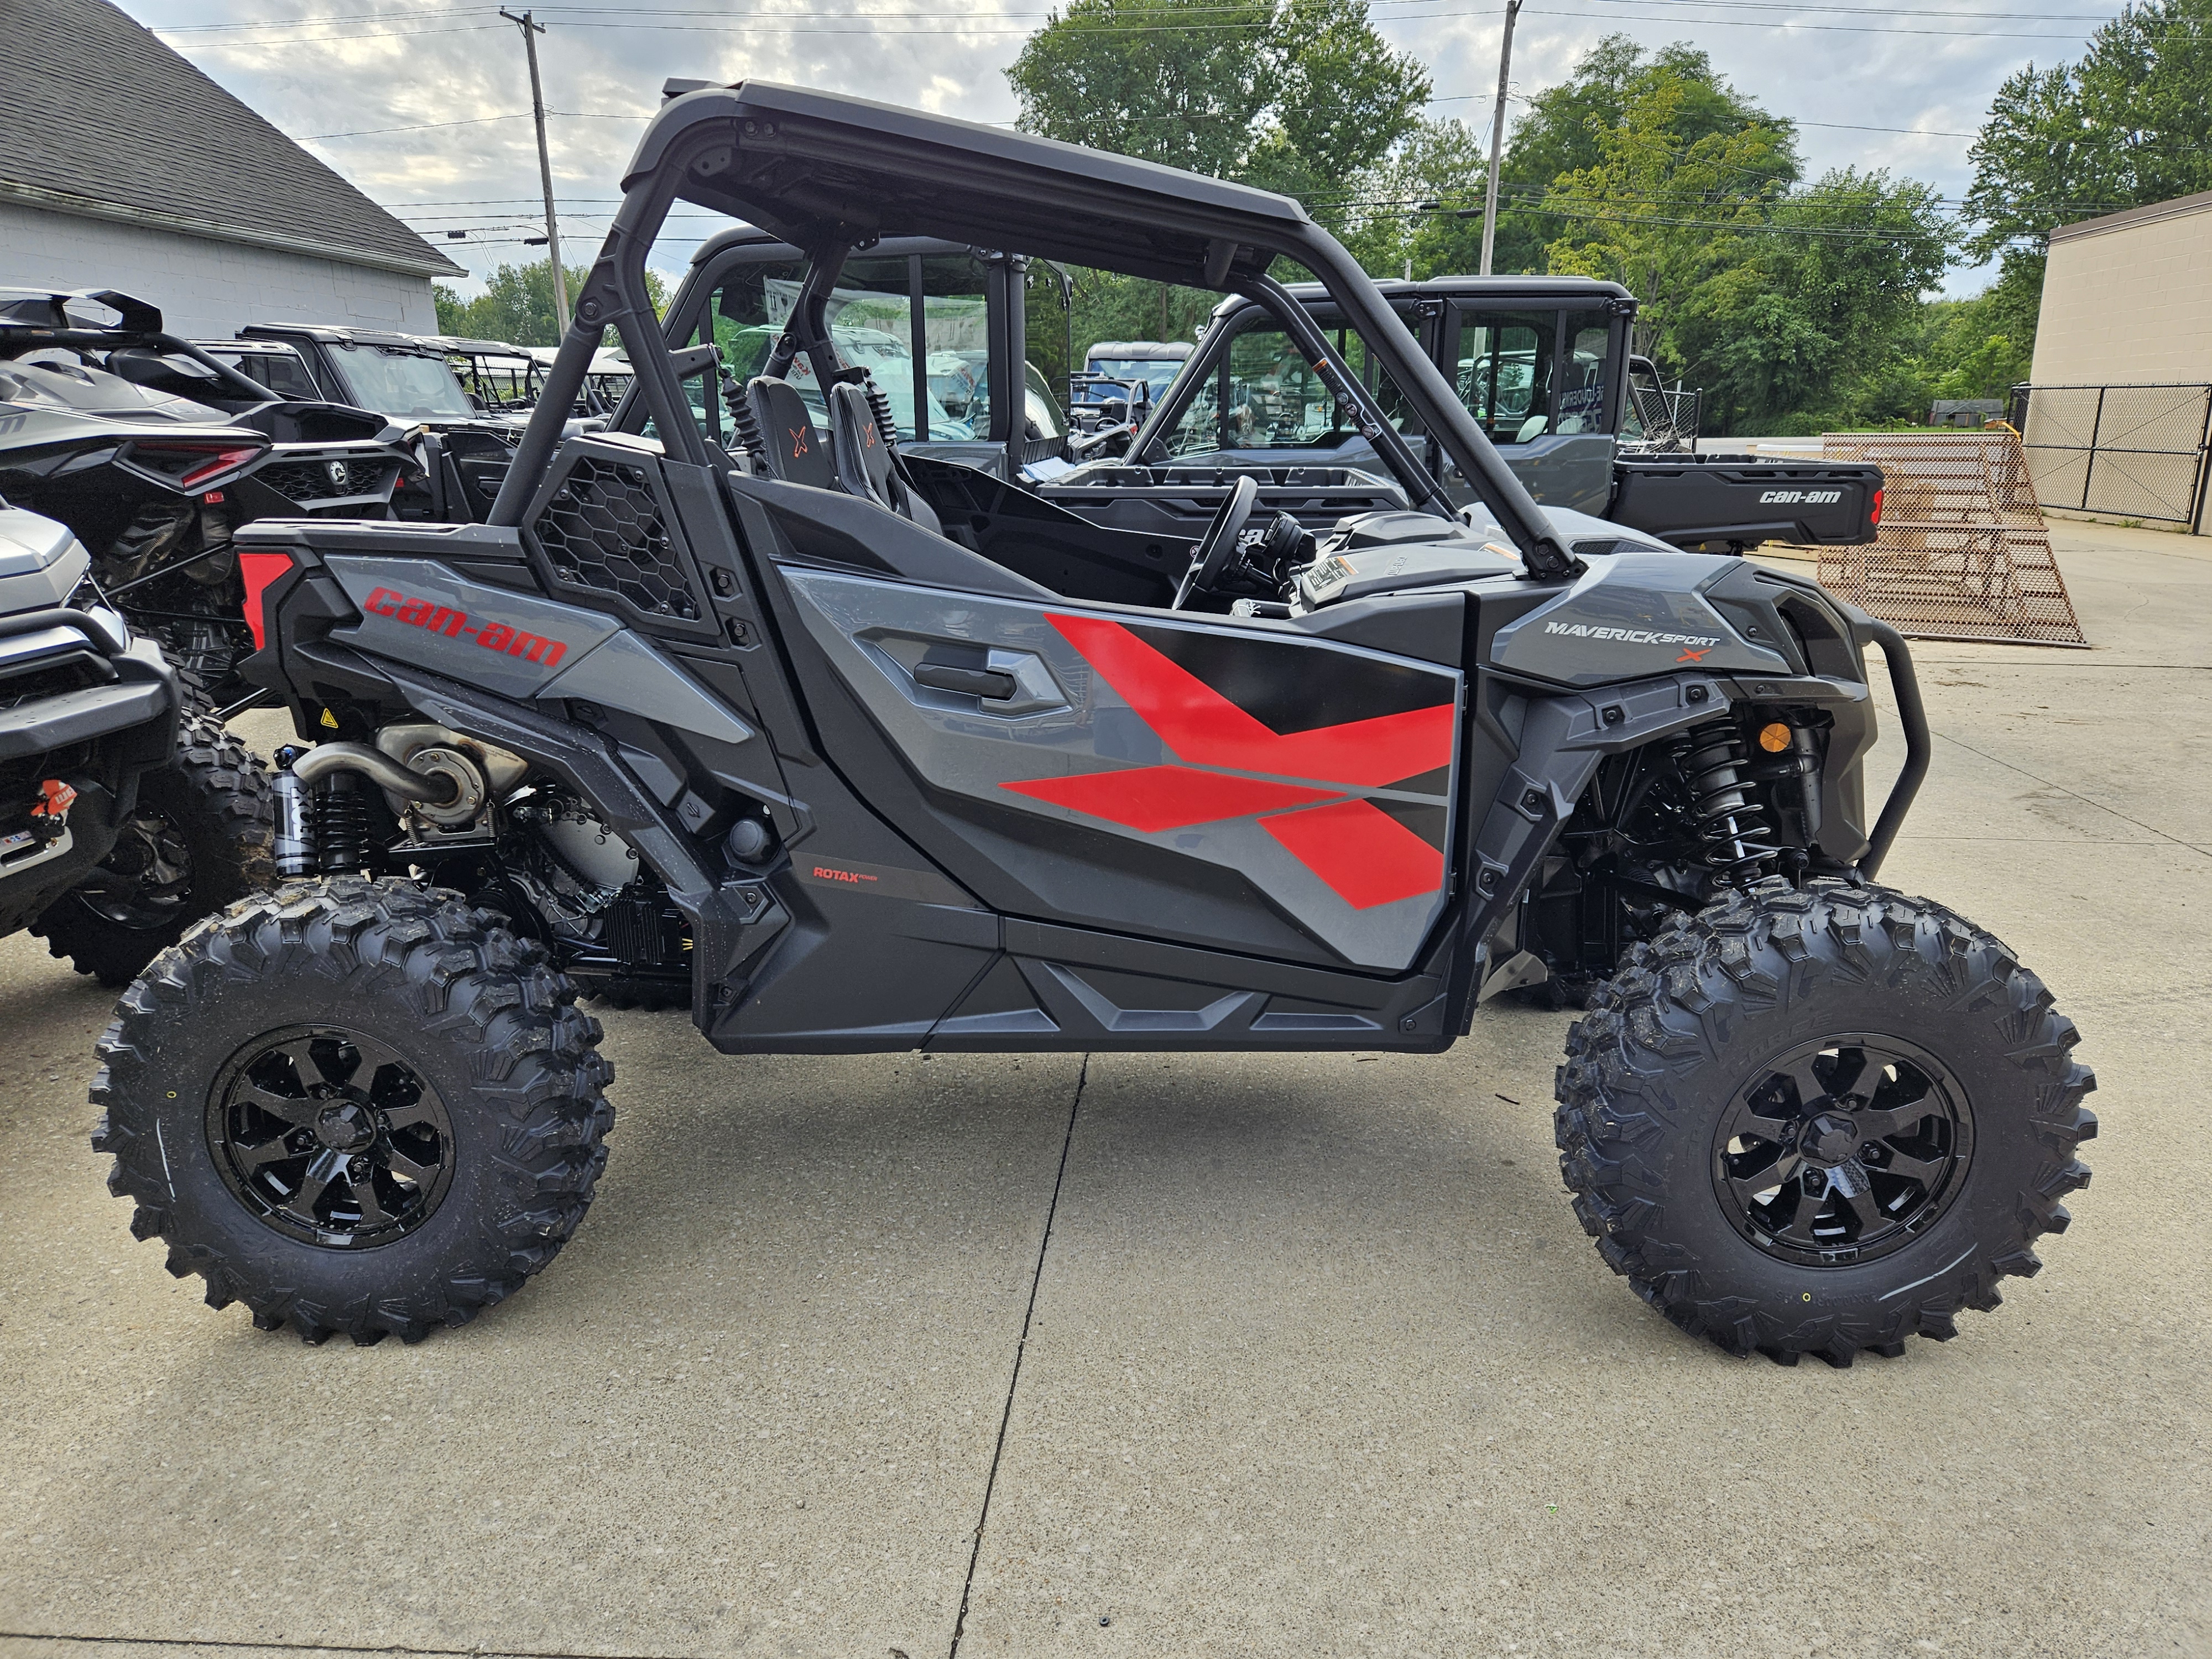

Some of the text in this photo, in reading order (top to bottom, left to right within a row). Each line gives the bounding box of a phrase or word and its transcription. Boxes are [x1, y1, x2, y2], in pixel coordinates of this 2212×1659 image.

[1759, 491, 1841, 504] can-am
[363, 586, 568, 668] can-am
[1545, 622, 1720, 646] MAVERICK SPORT
[813, 867, 859, 883] ROTAX
